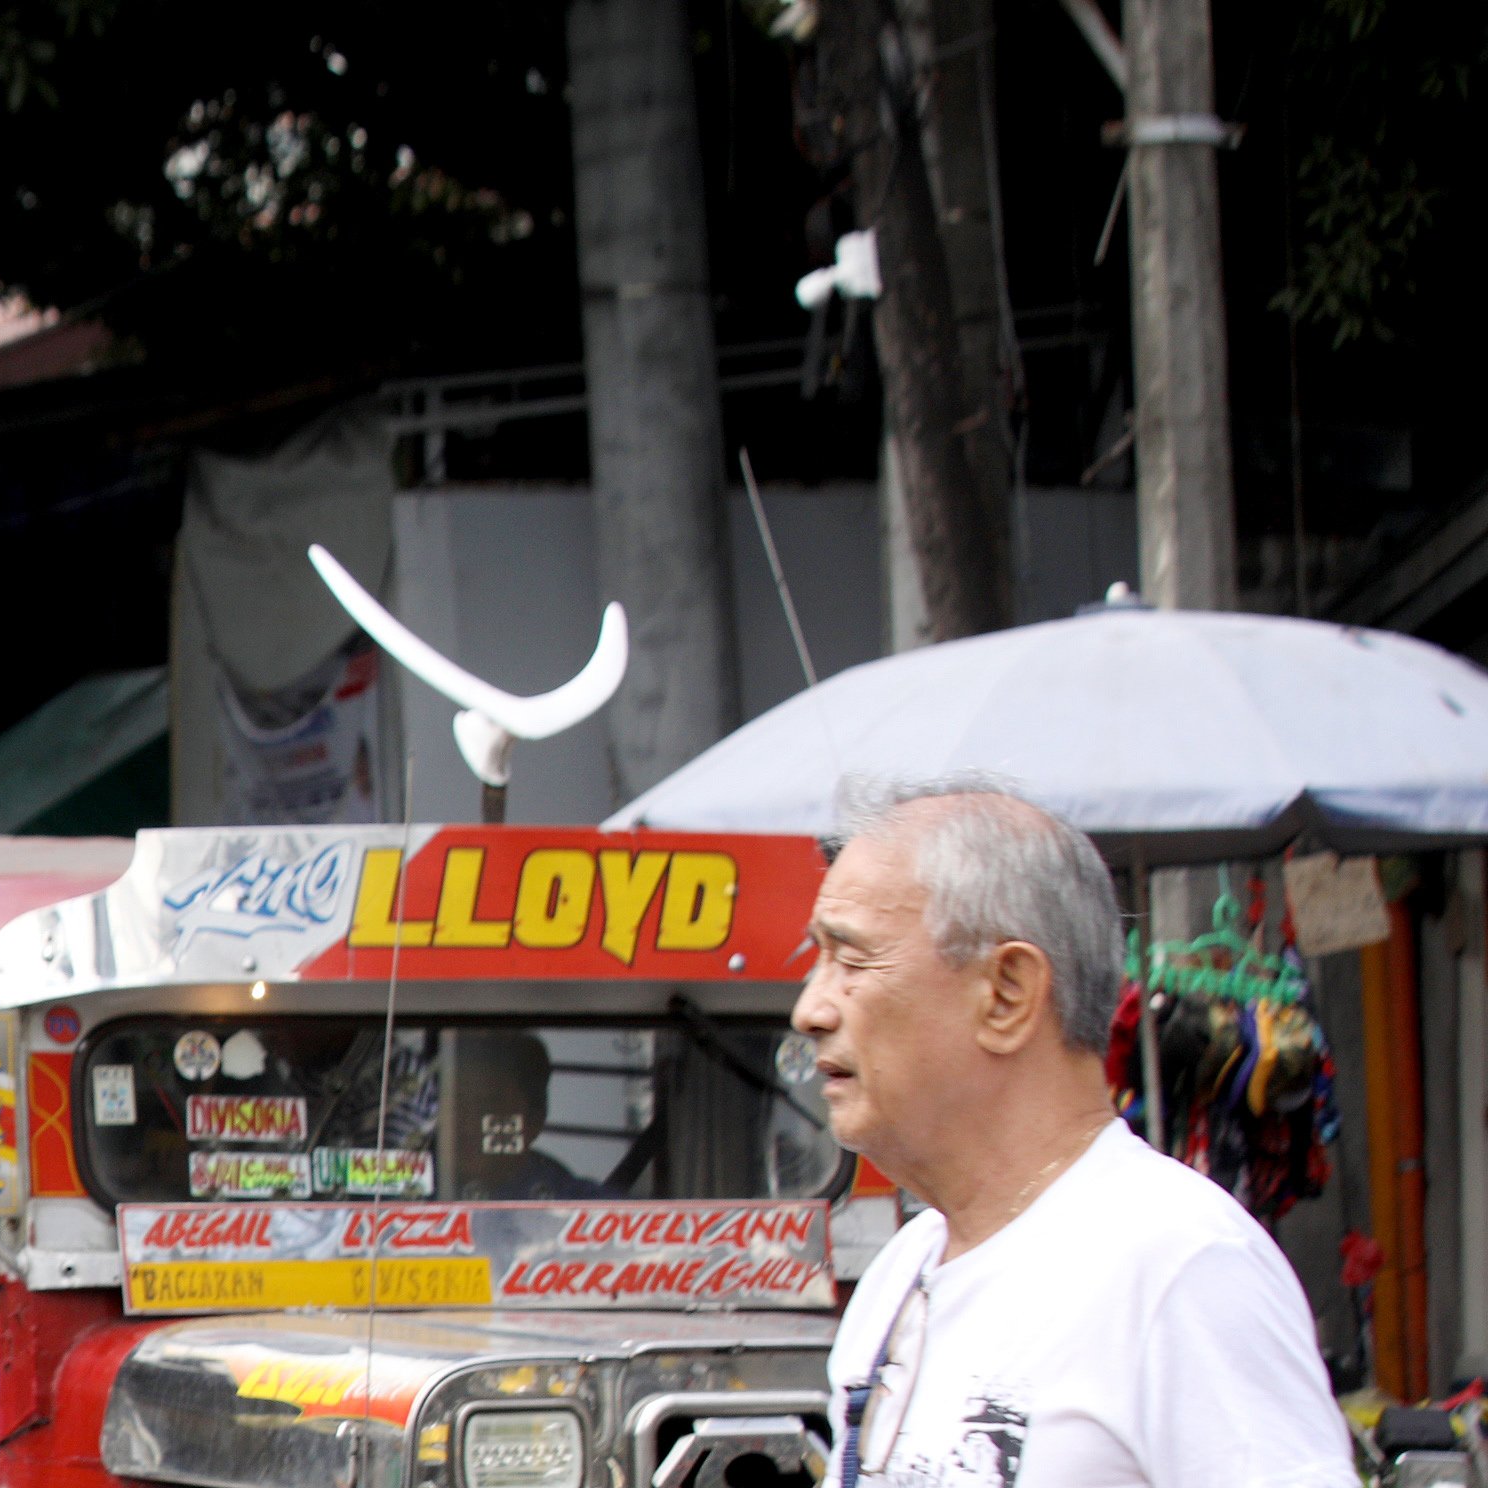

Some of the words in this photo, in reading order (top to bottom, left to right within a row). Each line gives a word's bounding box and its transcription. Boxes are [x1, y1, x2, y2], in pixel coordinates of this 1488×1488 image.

[347, 847, 738, 966] LLOYD
[143, 1211, 273, 1249] ABEGAIL
[341, 1210, 473, 1249] LYZZA
[502, 1259, 706, 1297] LORRAINE
